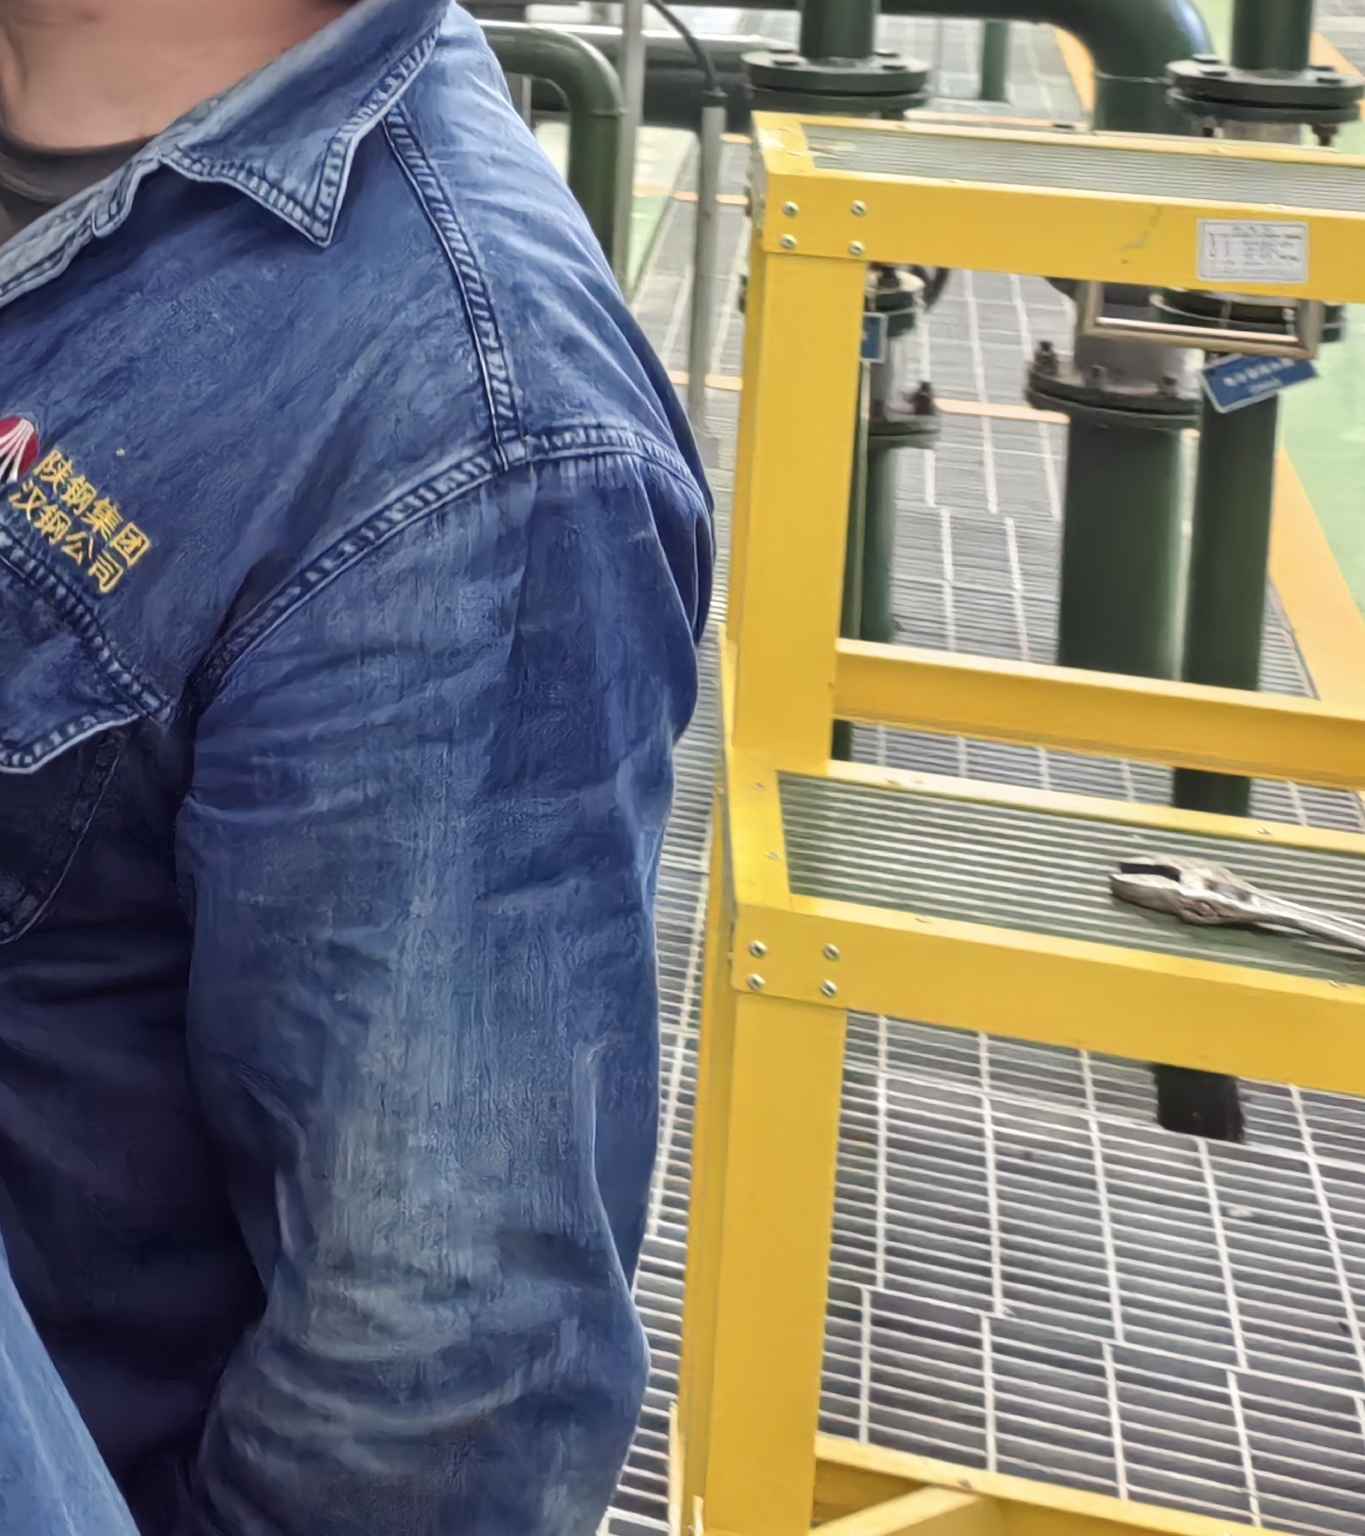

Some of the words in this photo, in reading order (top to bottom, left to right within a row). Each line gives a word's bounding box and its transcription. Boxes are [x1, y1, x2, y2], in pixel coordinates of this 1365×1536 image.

[9, 478, 125, 594] 汉钢公司
[33, 449, 151, 567] 陕钢集团
